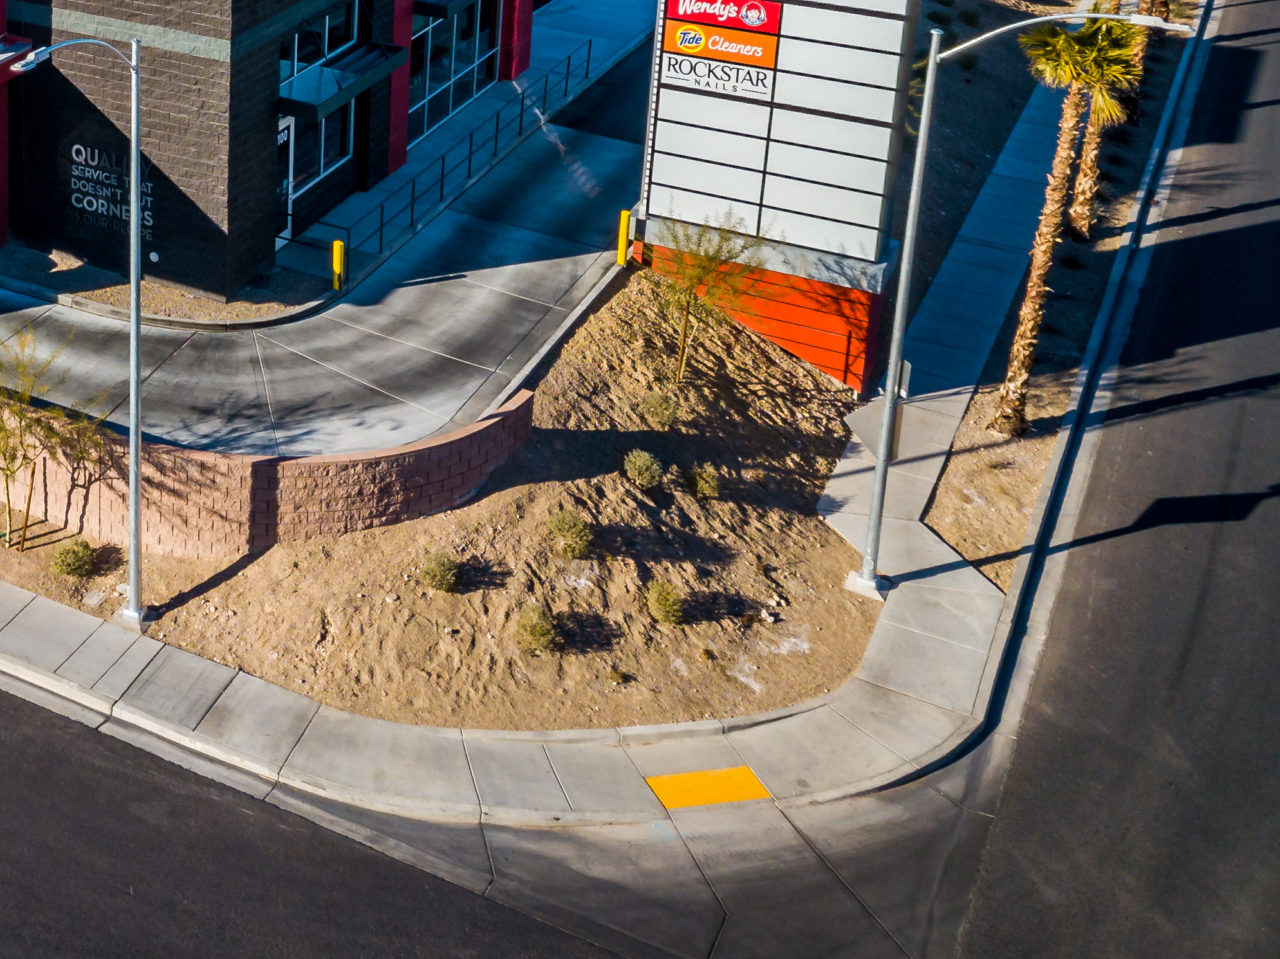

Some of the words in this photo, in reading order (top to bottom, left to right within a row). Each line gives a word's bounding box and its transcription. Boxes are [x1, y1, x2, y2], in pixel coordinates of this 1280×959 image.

[679, 31, 702, 46] Tide
[708, 35, 763, 57] Cleaners
[667, 56, 768, 89] ROCKSTAR
[695, 80, 738, 93] NAILS
[72, 144, 153, 181] QUALIY
[72, 164, 118, 186] SERVICE
[123, 177, 153, 195] TAT
[72, 178, 122, 201] DOESN'T
